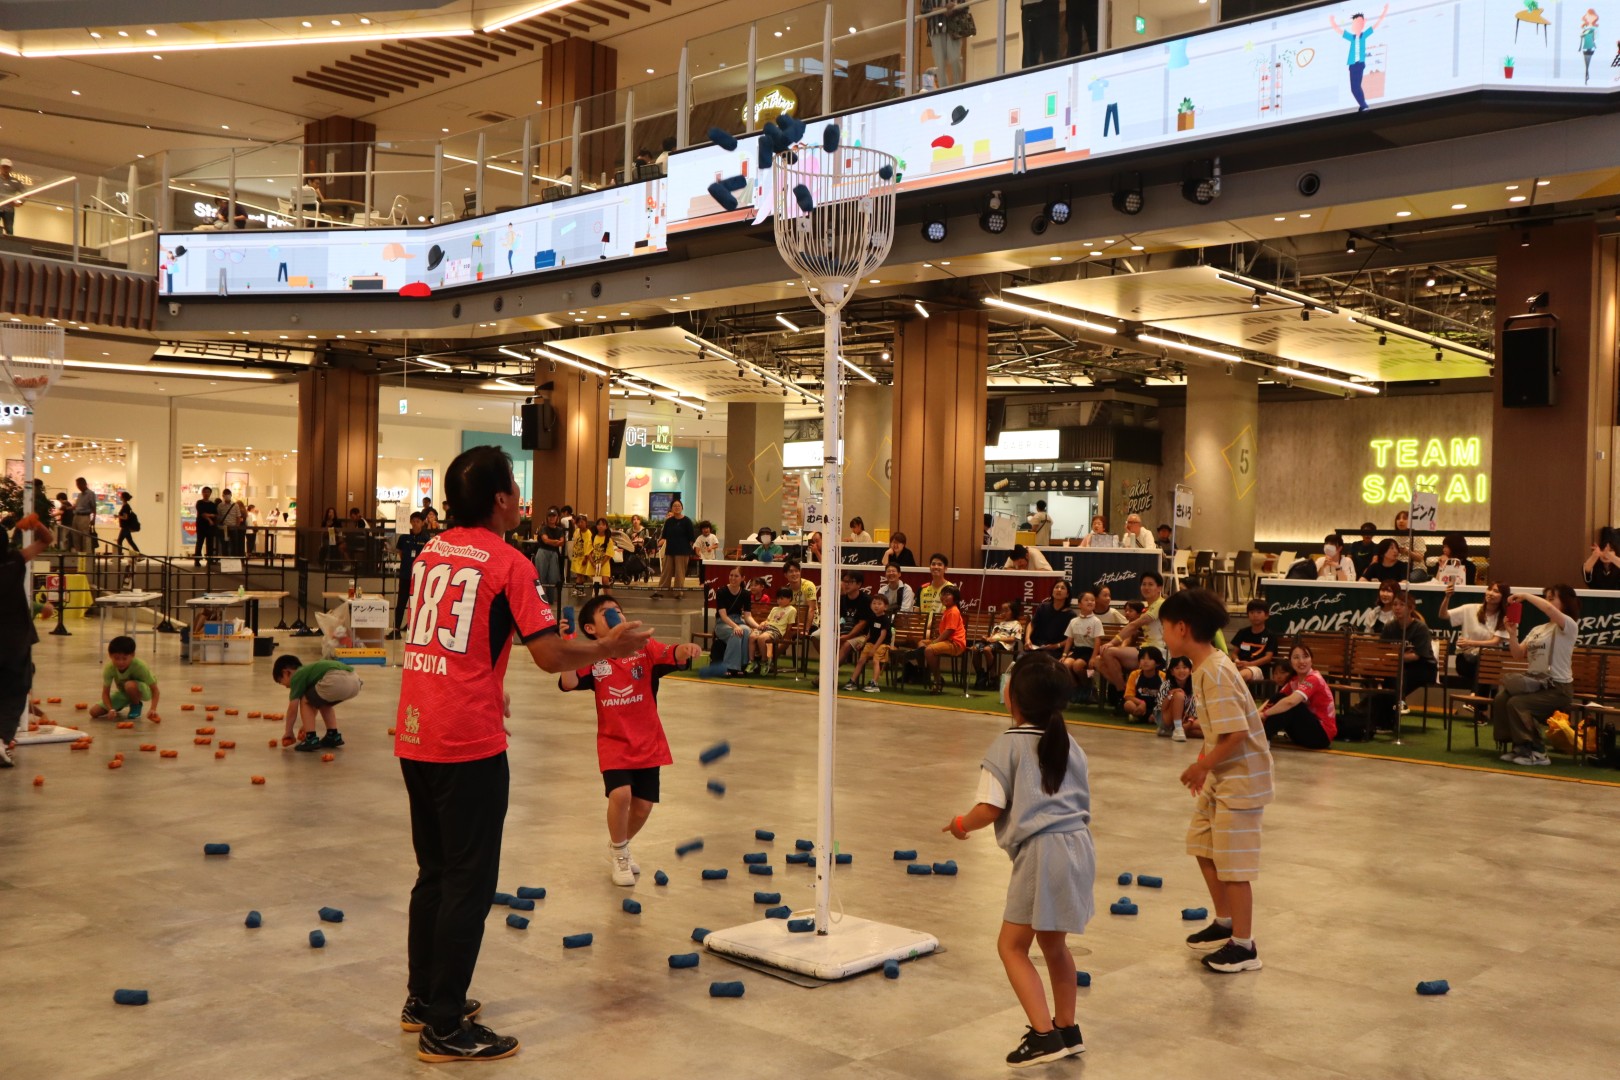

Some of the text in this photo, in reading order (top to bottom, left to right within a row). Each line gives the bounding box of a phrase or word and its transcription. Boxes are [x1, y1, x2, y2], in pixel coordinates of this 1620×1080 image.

[1240, 448, 1249, 475] 5
[1370, 437, 1480, 468] TEAM
[1362, 473, 1487, 503] SAKAI
[435, 542, 488, 561] Nipponham
[353, 605, 387, 613] アンケート
[601, 694, 643, 706] YANMAR
